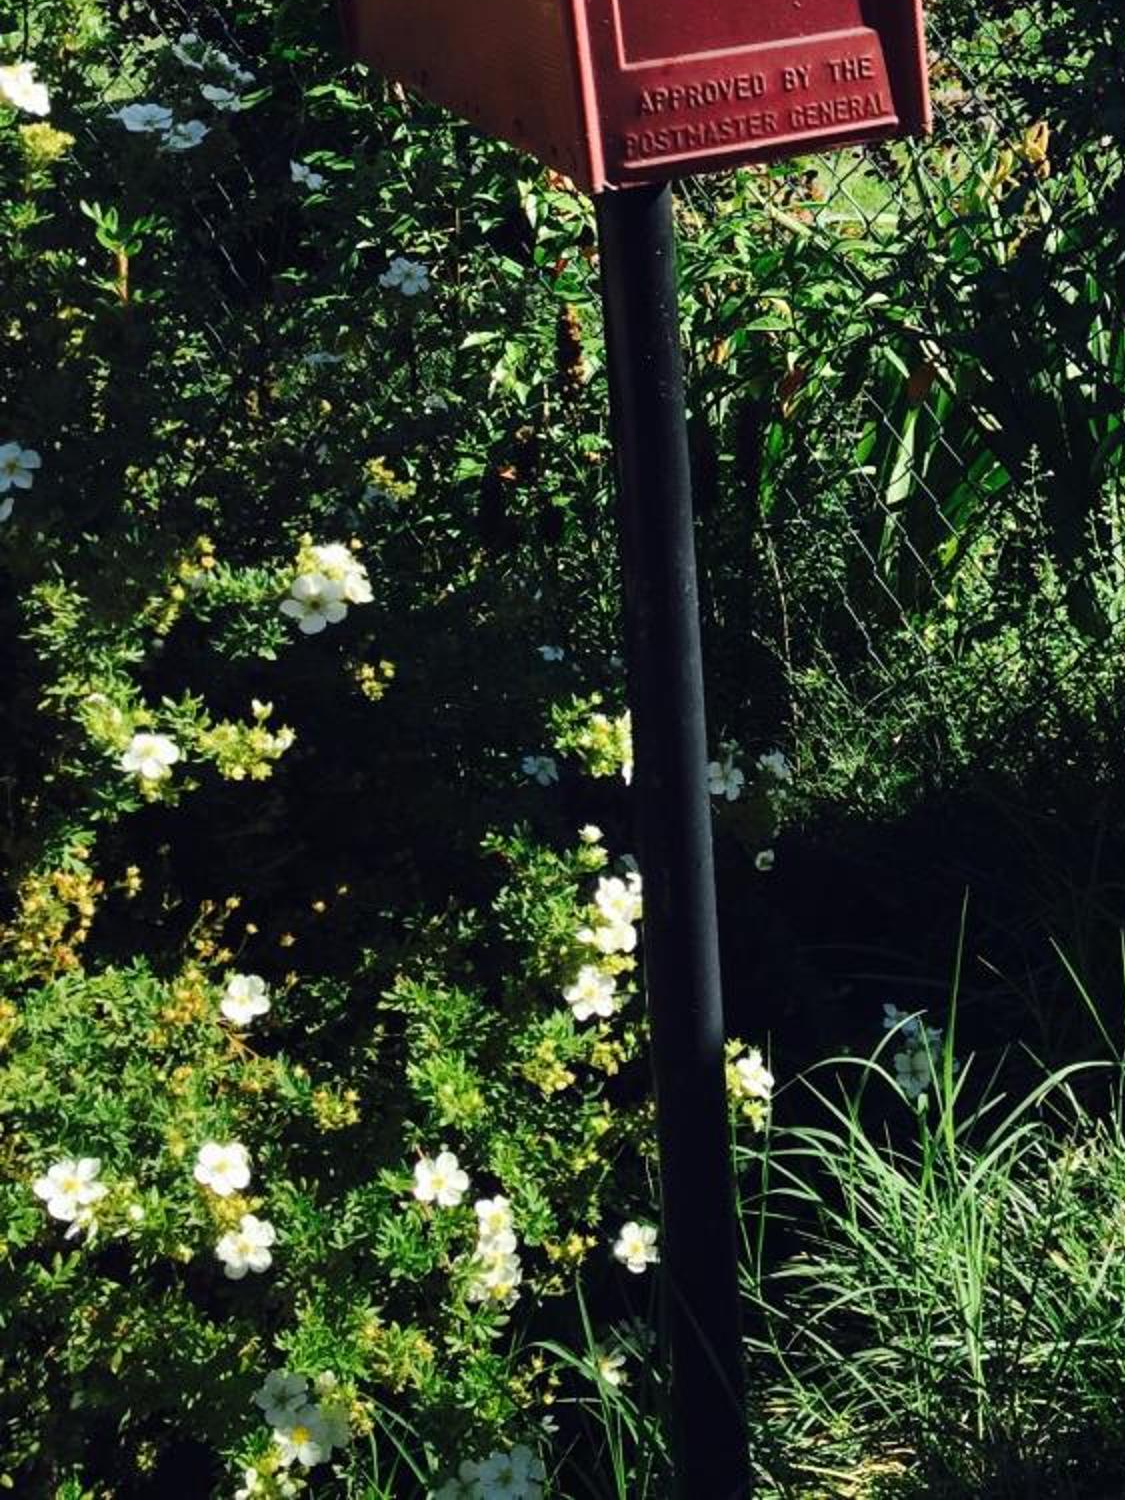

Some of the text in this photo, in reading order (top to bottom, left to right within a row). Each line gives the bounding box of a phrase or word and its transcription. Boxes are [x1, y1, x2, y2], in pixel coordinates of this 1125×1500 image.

[638, 54, 875, 116] APPROVED BY THE
[625, 92, 891, 156] POSTMASTER GENERAL
